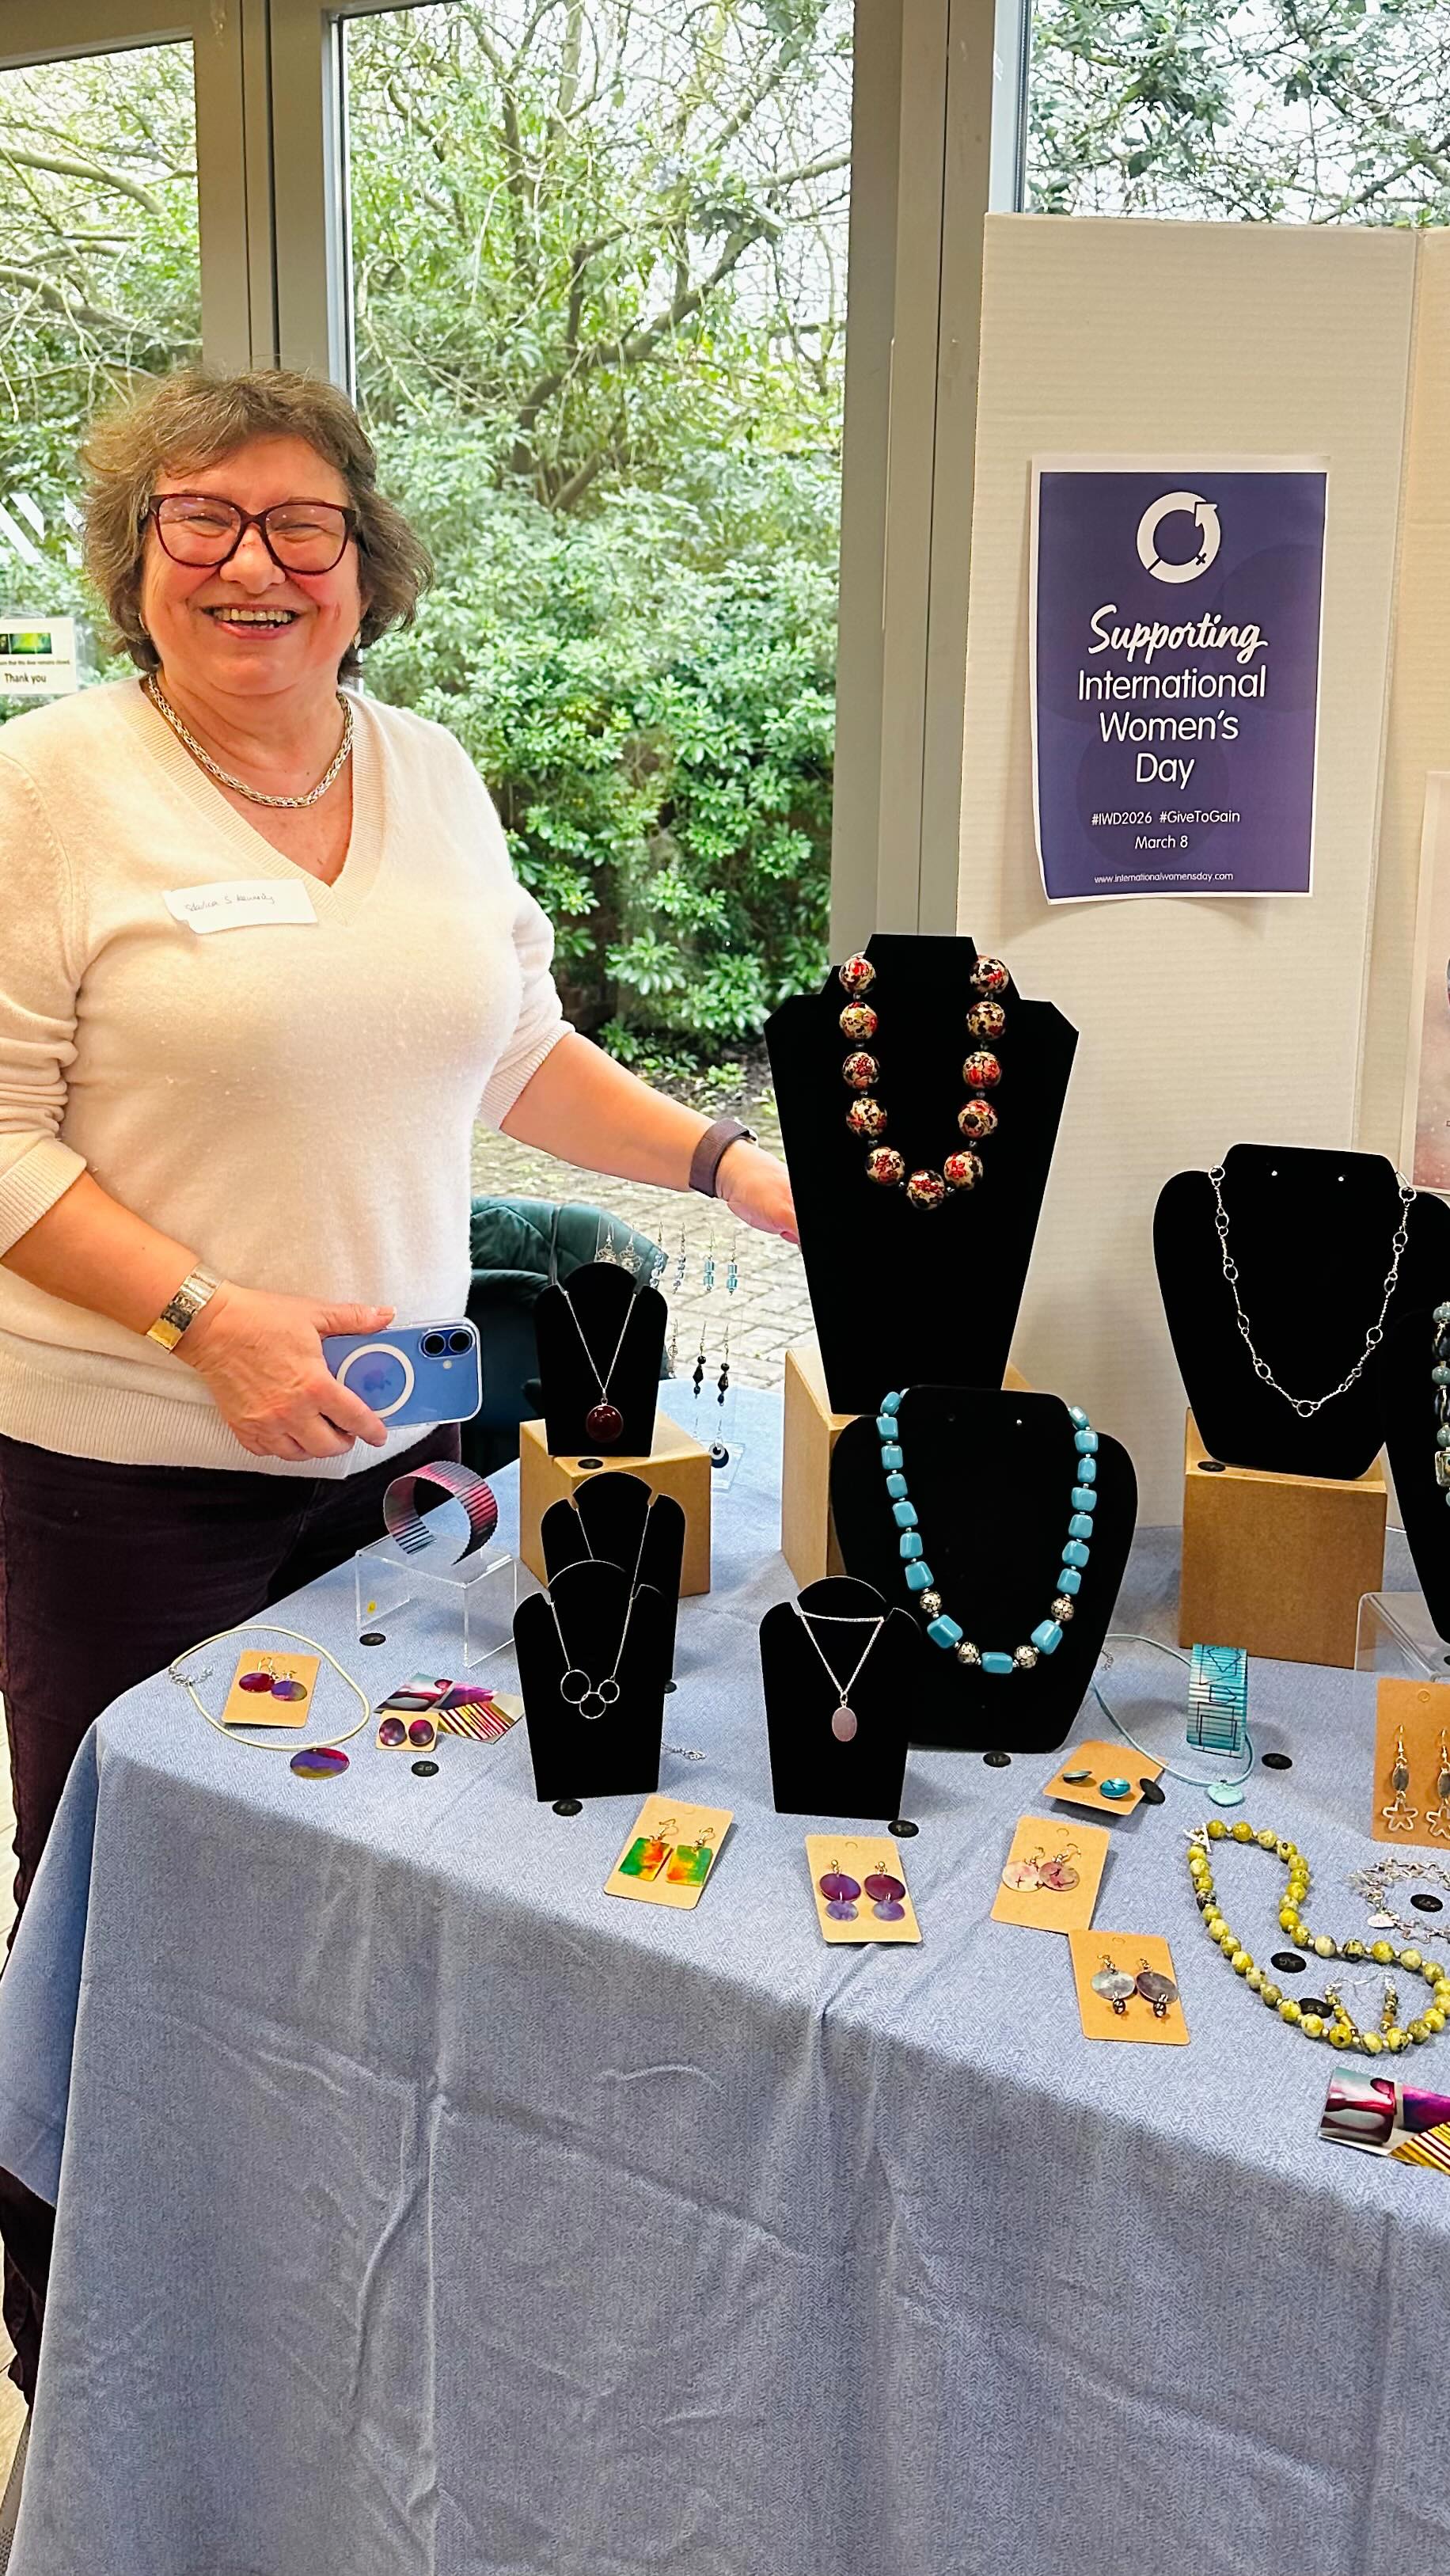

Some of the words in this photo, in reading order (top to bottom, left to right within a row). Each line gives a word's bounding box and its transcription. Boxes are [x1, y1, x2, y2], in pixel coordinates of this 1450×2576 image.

[1088, 604, 1269, 664] Supporting
[5, 674, 28, 682] Thank
[1078, 664, 1266, 701] International
[1099, 709, 1239, 743] Women's
[1135, 752, 1195, 790] Day
[1091, 811, 1152, 826] #IWD2026
[1159, 810, 1241, 824] #GiveToGain
[1134, 834, 1176, 849] March
[1179, 835, 1189, 849] 8
[1094, 872, 1235, 883] www.internationalwomensday.com
